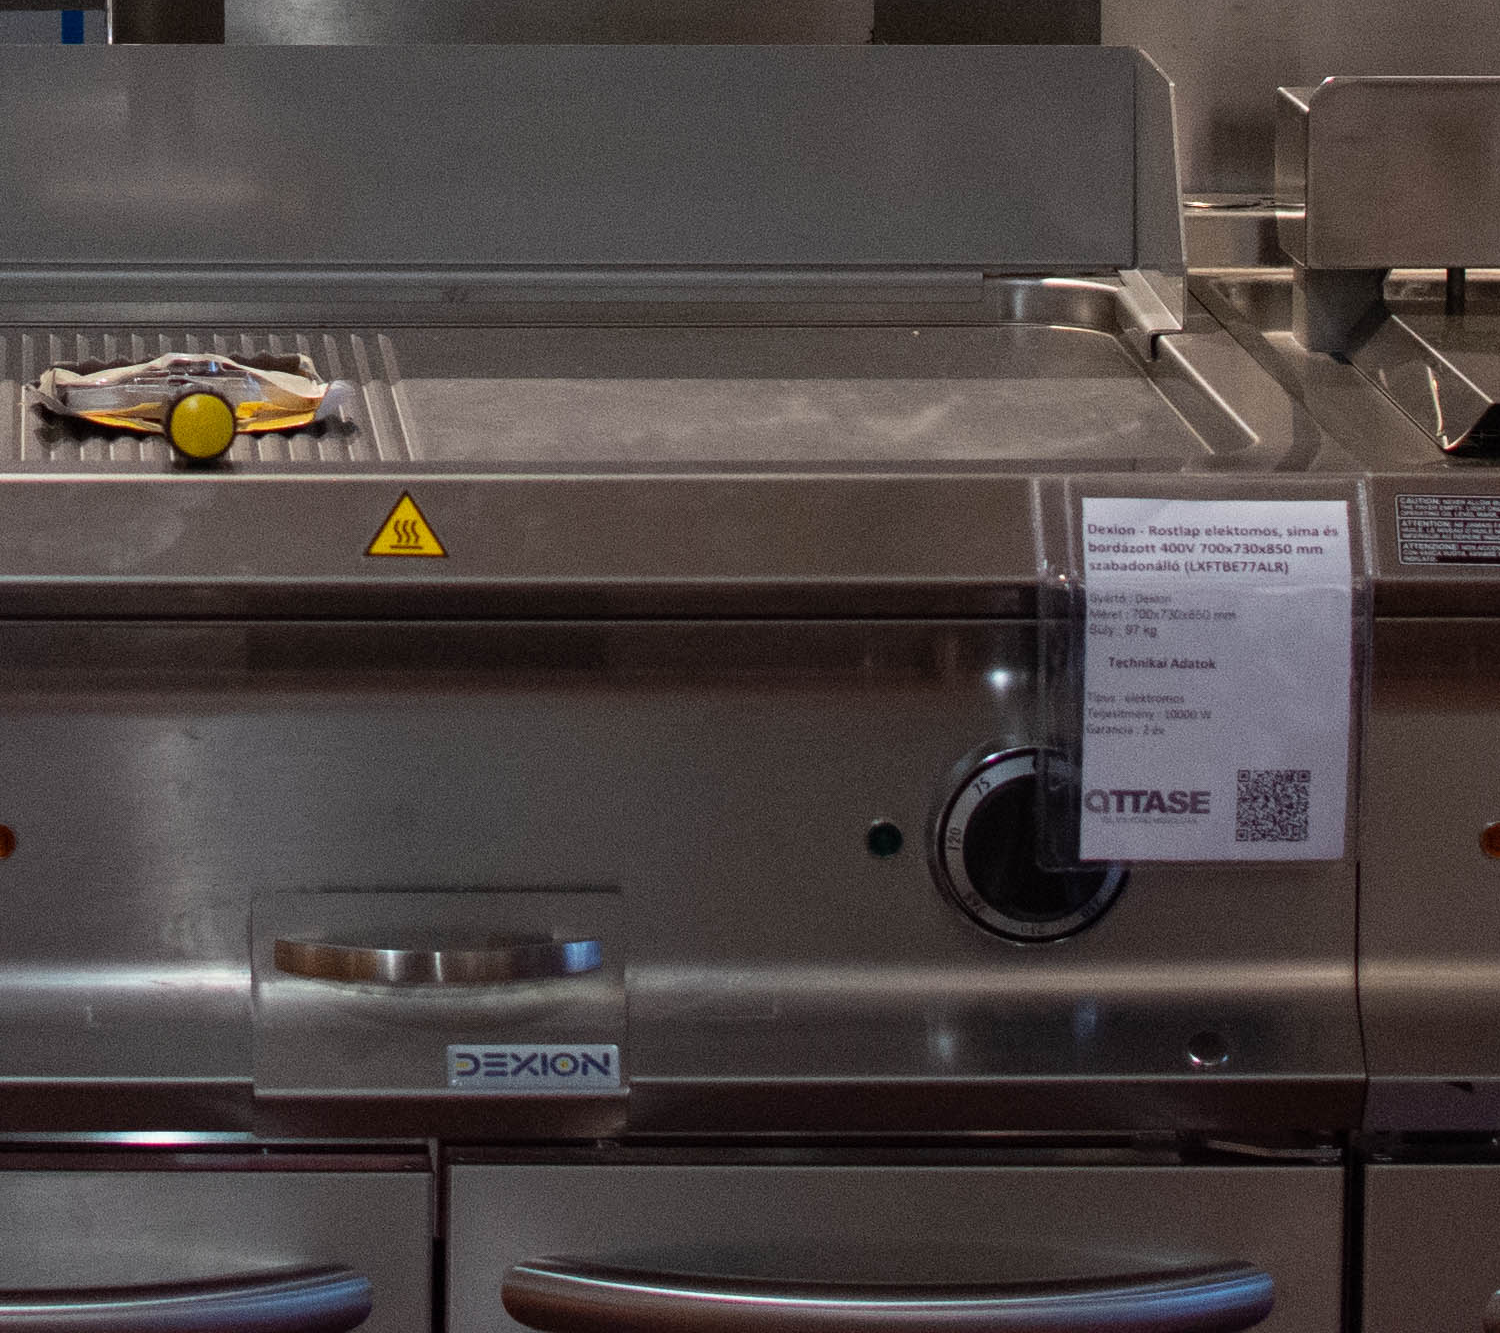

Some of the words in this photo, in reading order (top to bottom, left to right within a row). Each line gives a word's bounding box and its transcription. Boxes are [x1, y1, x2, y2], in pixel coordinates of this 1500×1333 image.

[1088, 523, 1136, 535] Dexion
[1159, 543, 1196, 554] 400V
[1295, 544, 1324, 555] mm
[971, 777, 991, 796] 75
[455, 1052, 611, 1077] DEXION
